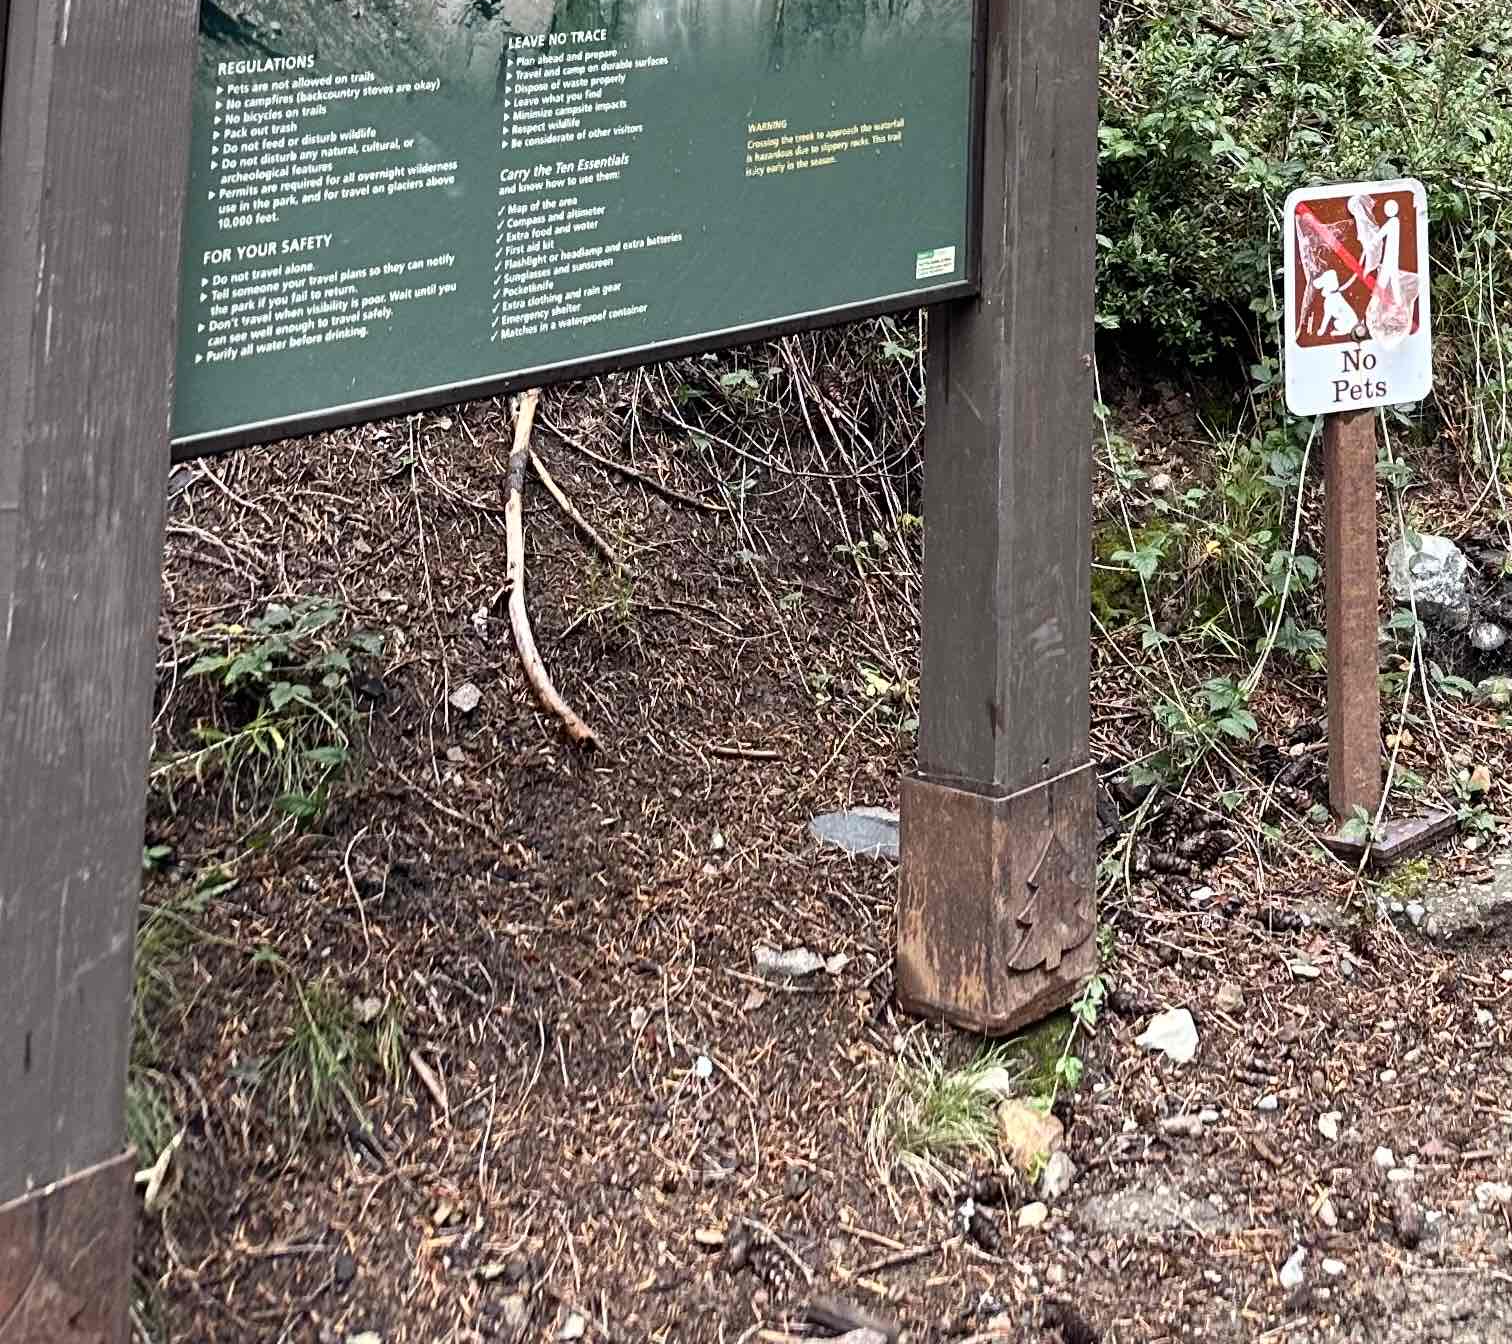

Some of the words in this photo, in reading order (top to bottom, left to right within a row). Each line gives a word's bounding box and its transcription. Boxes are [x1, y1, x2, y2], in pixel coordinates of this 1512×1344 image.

[507, 34, 545, 50] LEAVE
[548, 32, 568, 45] NO
[570, 28, 606, 43] TRACE
[217, 54, 314, 75] REGULATIONS
[227, 83, 249, 94] Pets
[251, 82, 268, 92] are
[271, 79, 289, 90] not
[291, 74, 332, 88] allowed
[334, 75, 347, 84] on
[350, 71, 374, 83] trails
[224, 113, 240, 124] No
[242, 109, 282, 123] bicycles
[285, 108, 298, 118] on
[301, 104, 326, 116] trails
[222, 143, 238, 154] Do
[240, 140, 259, 152] not
[261, 137, 284, 149] feed
[287, 137, 299, 146] or
[301, 131, 337, 145] disturb
[339, 126, 376, 140] wildlife
[223, 127, 247, 139] Pack
[249, 125, 268, 136] out
[271, 121, 297, 133] trash
[499, 168, 530, 181] Carry
[533, 163, 552, 176] the
[555, 161, 574, 173] Ten
[577, 152, 629, 171] Essentials
[203, 248, 231, 264] FOR
[236, 241, 276, 259] YOUR
[281, 233, 332, 253] SAFETY
[212, 274, 228, 285] Do
[230, 270, 249, 283] not
[251, 264, 282, 279] travel
[1341, 348, 1376, 373] No
[1332, 378, 1388, 403] Pets
